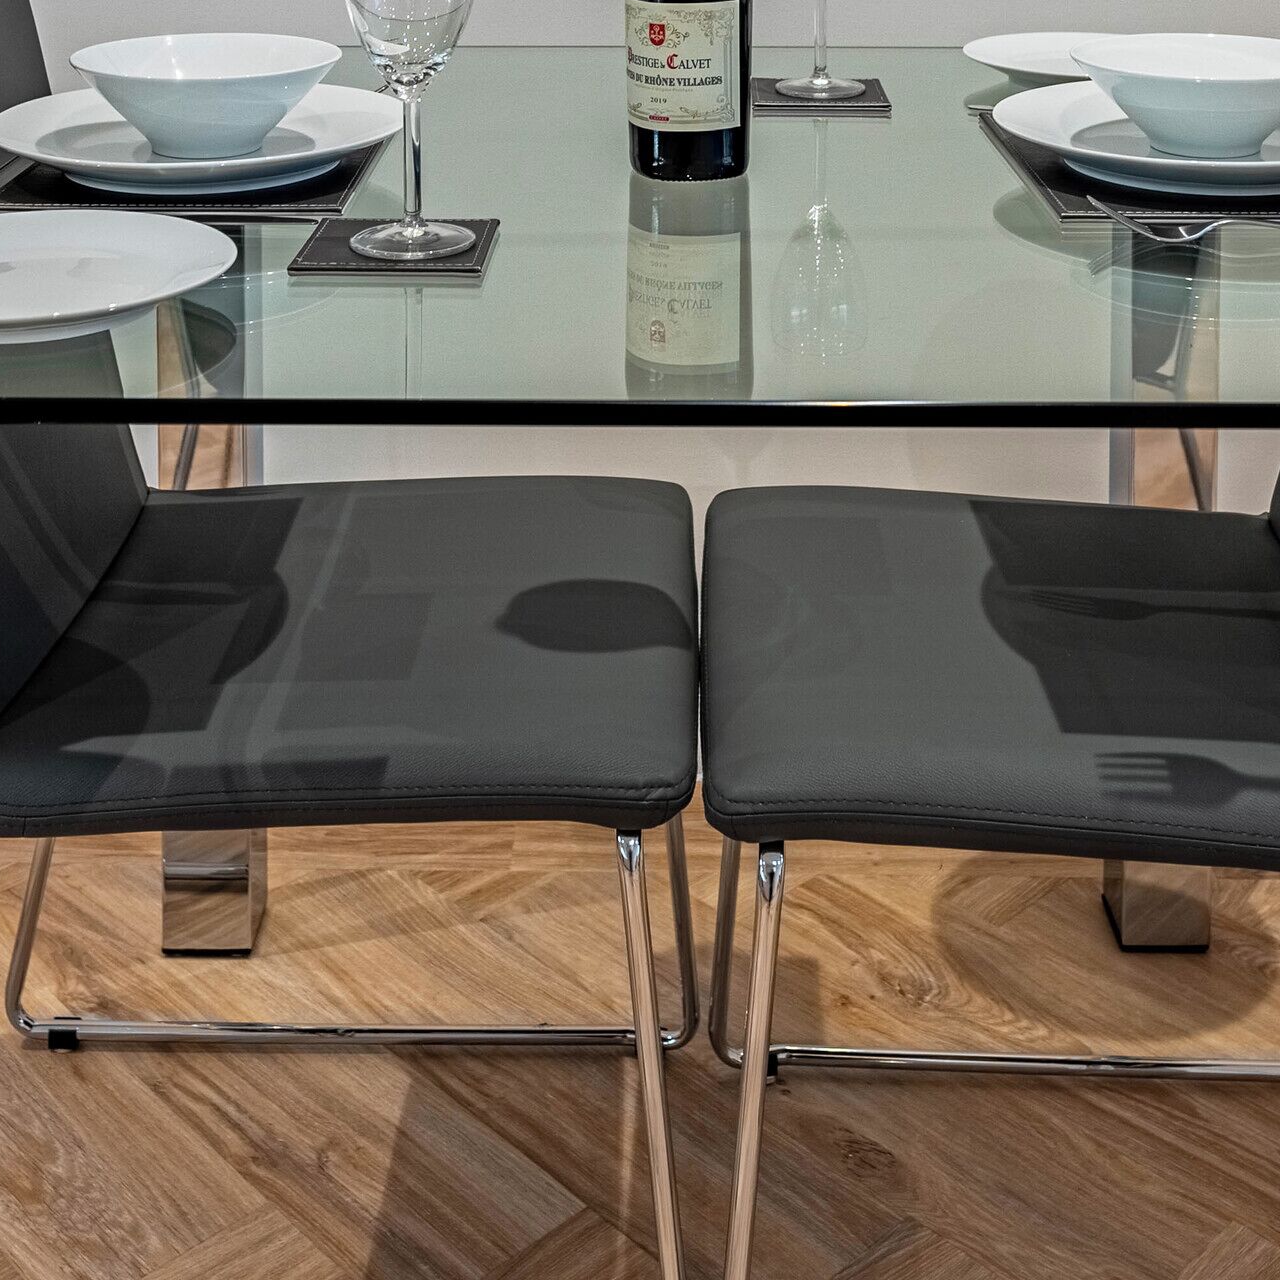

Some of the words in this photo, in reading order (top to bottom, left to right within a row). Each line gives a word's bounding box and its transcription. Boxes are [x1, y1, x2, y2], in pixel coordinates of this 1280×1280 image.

[628, 45, 659, 68] PRESTIGE
[666, 53, 712, 69] CALVET
[644, 74, 675, 86] RHÔNE
[676, 75, 723, 86] VILLAGES
